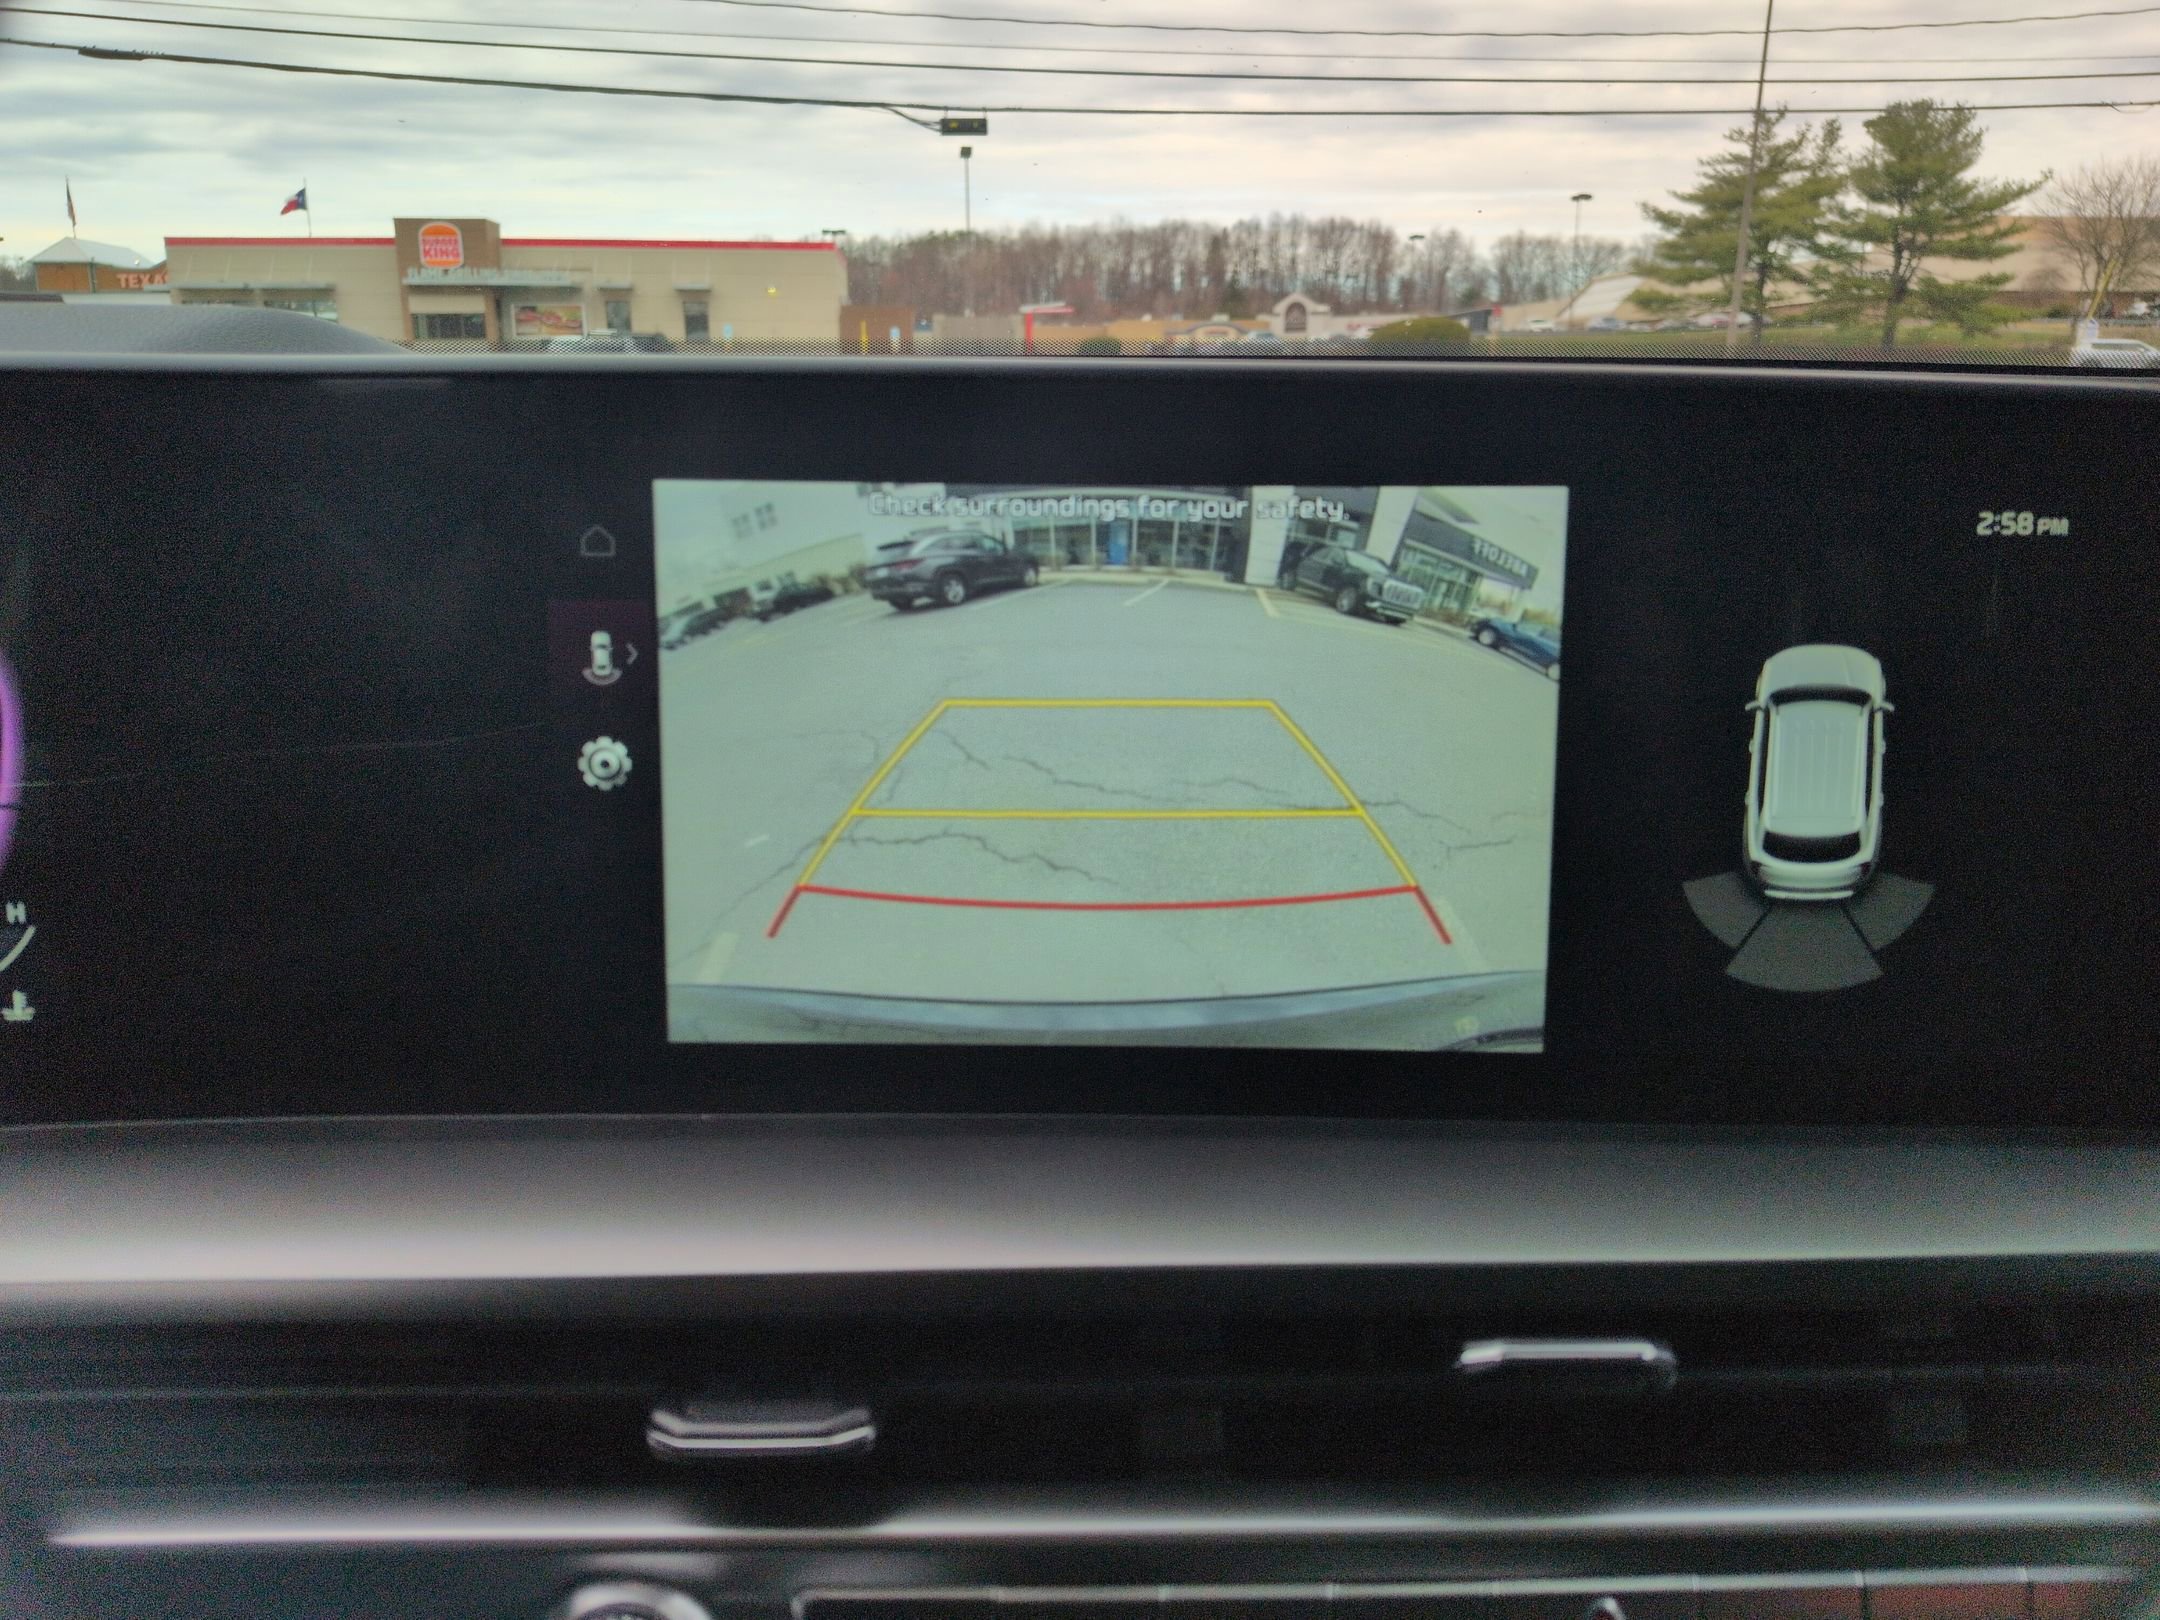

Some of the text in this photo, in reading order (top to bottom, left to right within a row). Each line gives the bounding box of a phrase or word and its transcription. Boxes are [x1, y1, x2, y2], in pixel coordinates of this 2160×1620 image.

[423, 246, 460, 259] KING
[869, 491, 1350, 523] Check surroundings for your safety.
[1976, 510, 2069, 536] 2:58 PM
